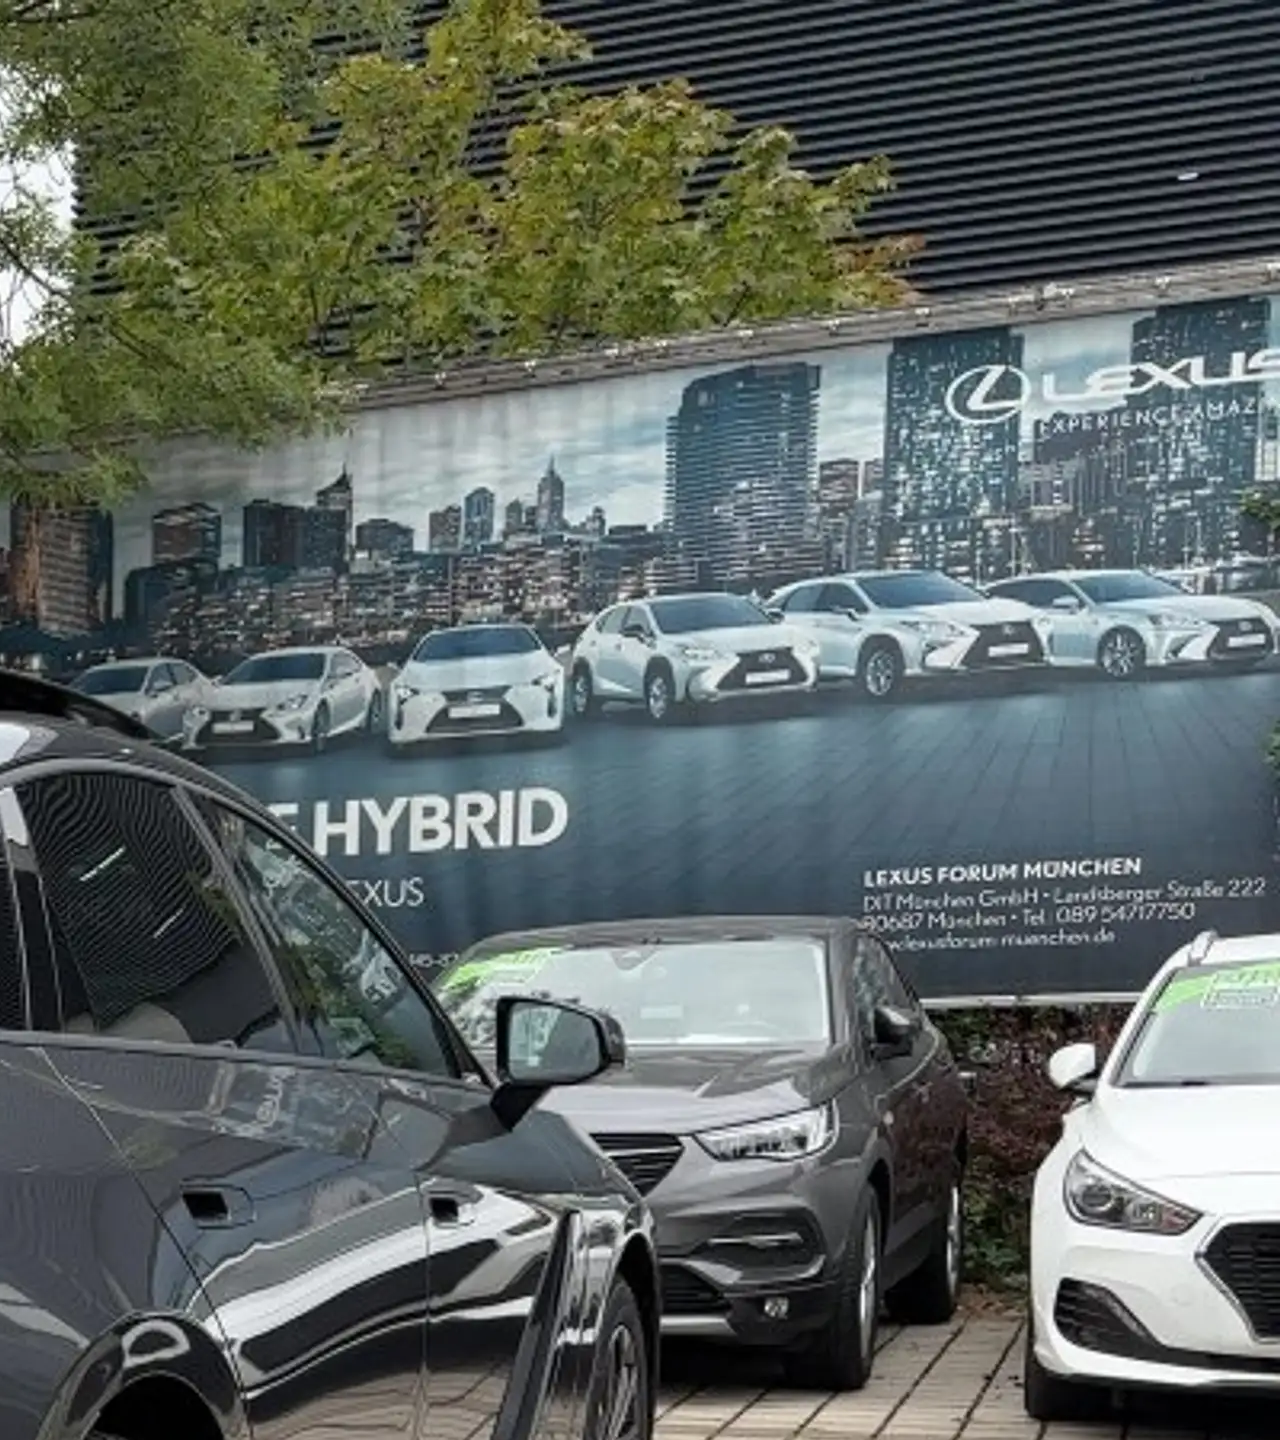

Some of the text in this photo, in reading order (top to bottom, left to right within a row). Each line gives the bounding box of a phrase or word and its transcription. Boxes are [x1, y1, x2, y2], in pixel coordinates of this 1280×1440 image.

[1040, 395, 1278, 435] EXPERIENCE AMAZ
[312, 787, 569, 857] HYBRID
[863, 857, 1141, 888] LEXUS FORUM MÜNCHEN
[346, 876, 425, 908] XUS
[978, 888, 1039, 907] GmbH
[1054, 884, 1162, 904] Landsberger
[1167, 879, 1224, 899] Straße
[1228, 877, 1266, 898] 222
[1055, 904, 1097, 924] 089
